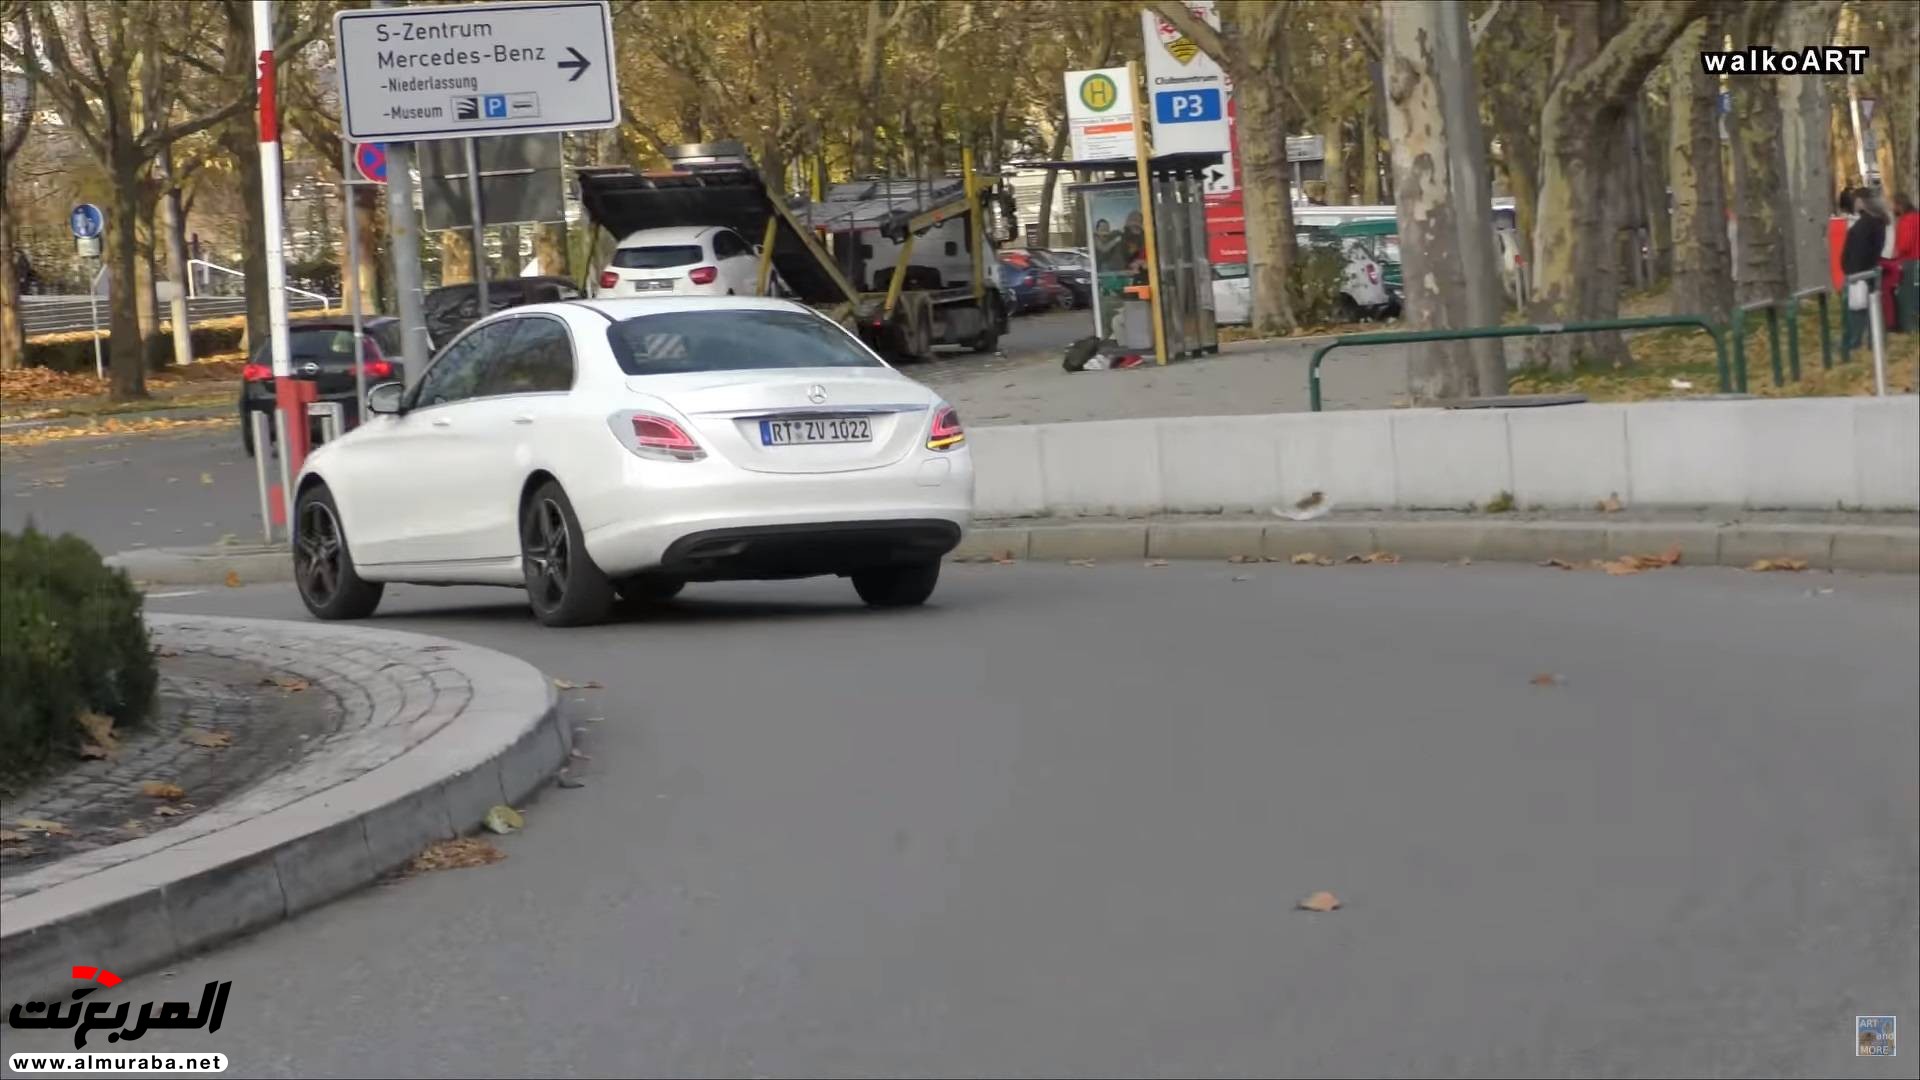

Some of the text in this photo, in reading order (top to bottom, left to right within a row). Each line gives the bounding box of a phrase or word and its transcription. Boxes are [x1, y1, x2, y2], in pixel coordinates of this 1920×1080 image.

[376, 21, 492, 42] S-Zentrum
[377, 44, 546, 69] Mercedes-Benz
[380, 75, 478, 92] -Niederlassung
[1090, 81, 1106, 105] H
[383, 104, 443, 119] -Museum
[1172, 94, 1204, 118] P3
[772, 420, 869, 441] RT ZV 1022
